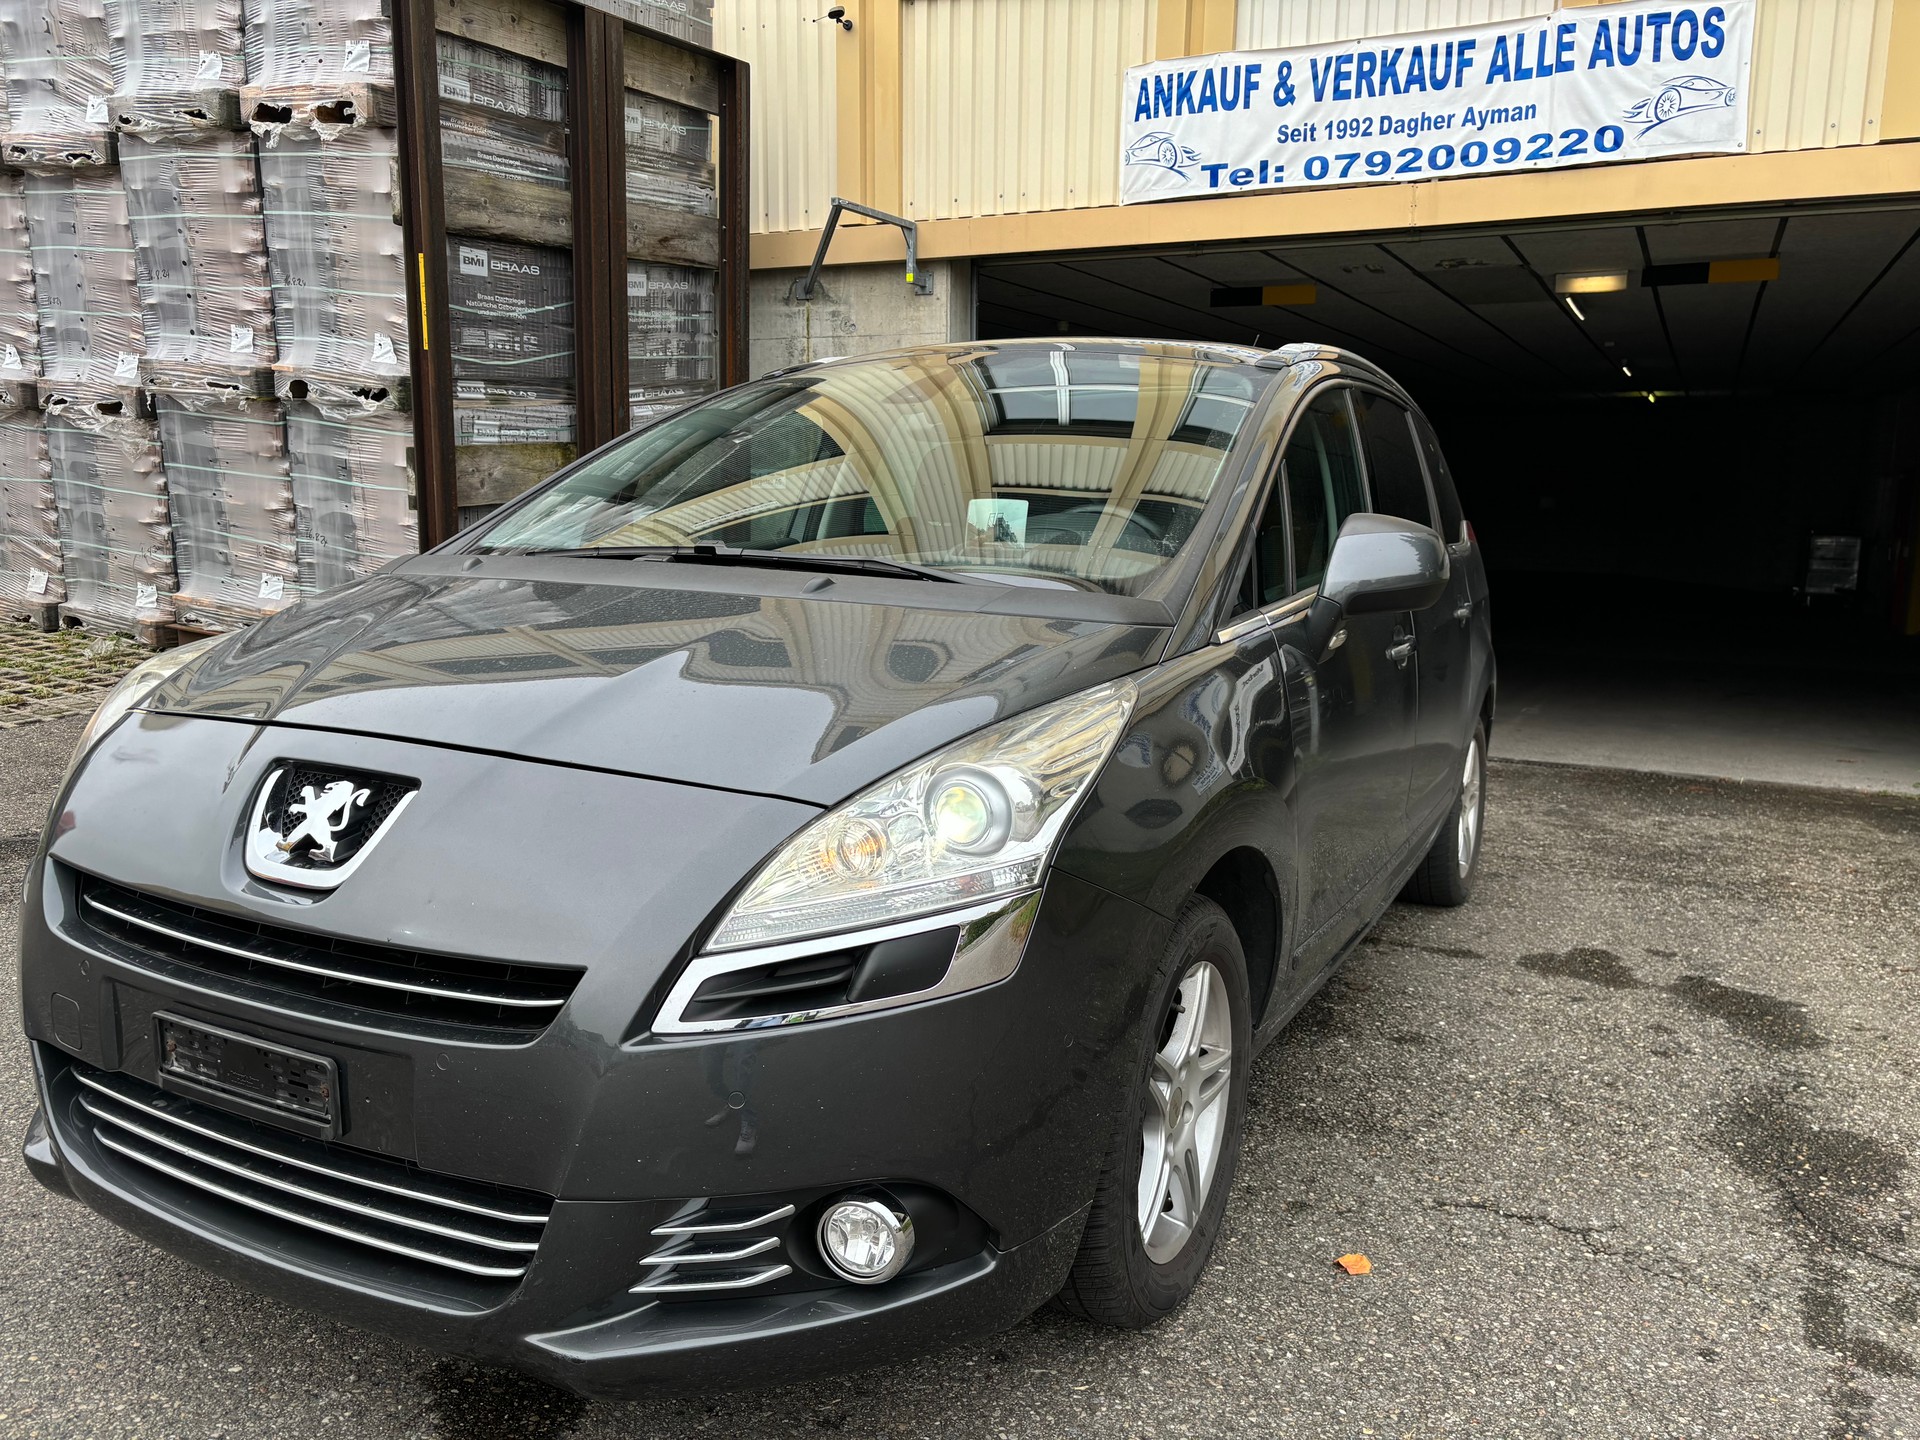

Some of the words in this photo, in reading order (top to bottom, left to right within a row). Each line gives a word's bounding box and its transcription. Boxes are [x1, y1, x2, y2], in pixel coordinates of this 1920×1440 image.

[1134, 63, 1263, 123] ANKAUF
[1272, 59, 1297, 108] &
[1309, 38, 1477, 103] VERKAUF
[1485, 22, 1578, 86] ALLE
[1587, 6, 1726, 70] AUTOS
[473, 92, 528, 118] BRAAS
[1277, 123, 1317, 145] Seit
[1325, 116, 1374, 140] 1992
[1379, 111, 1456, 139] Dagher
[1461, 103, 1537, 132] Ayman
[1200, 159, 1285, 189] Tel:
[1303, 124, 1625, 182] 0792009220
[463, 255, 485, 268] BMI
[490, 260, 540, 276] BRAAS
[477, 292, 495, 301] Braas
[628, 281, 645, 289] BMI
[648, 281, 689, 290] BRAAS
